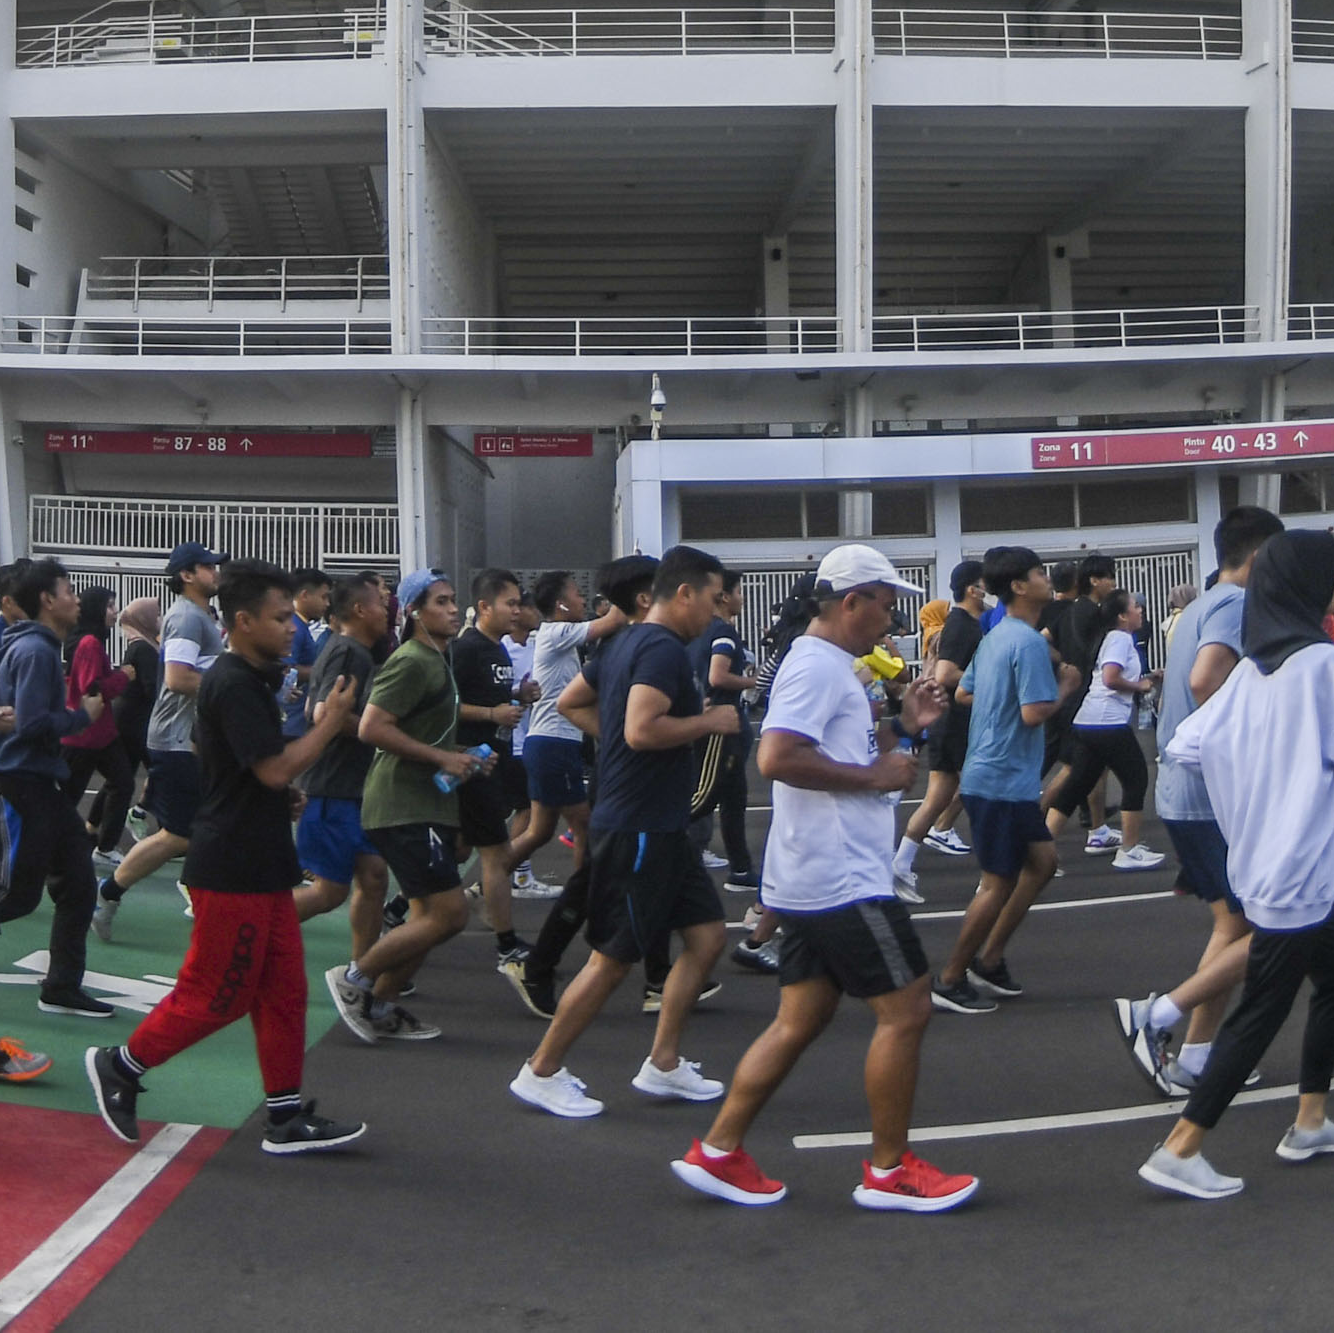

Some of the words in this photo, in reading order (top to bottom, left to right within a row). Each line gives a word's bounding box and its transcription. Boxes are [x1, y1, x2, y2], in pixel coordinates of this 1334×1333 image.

[174, 436, 193, 451] 87
[207, 437, 227, 452] 88
[1038, 443, 1061, 452] Zona
[1070, 441, 1093, 461] 11
[1183, 437, 1206, 447] Pintu
[1211, 434, 1236, 454] 40
[1253, 432, 1277, 451] 43
[1184, 448, 1201, 456] Door
[1039, 454, 1057, 462] Zone
[209, 922, 257, 1016] adidas
